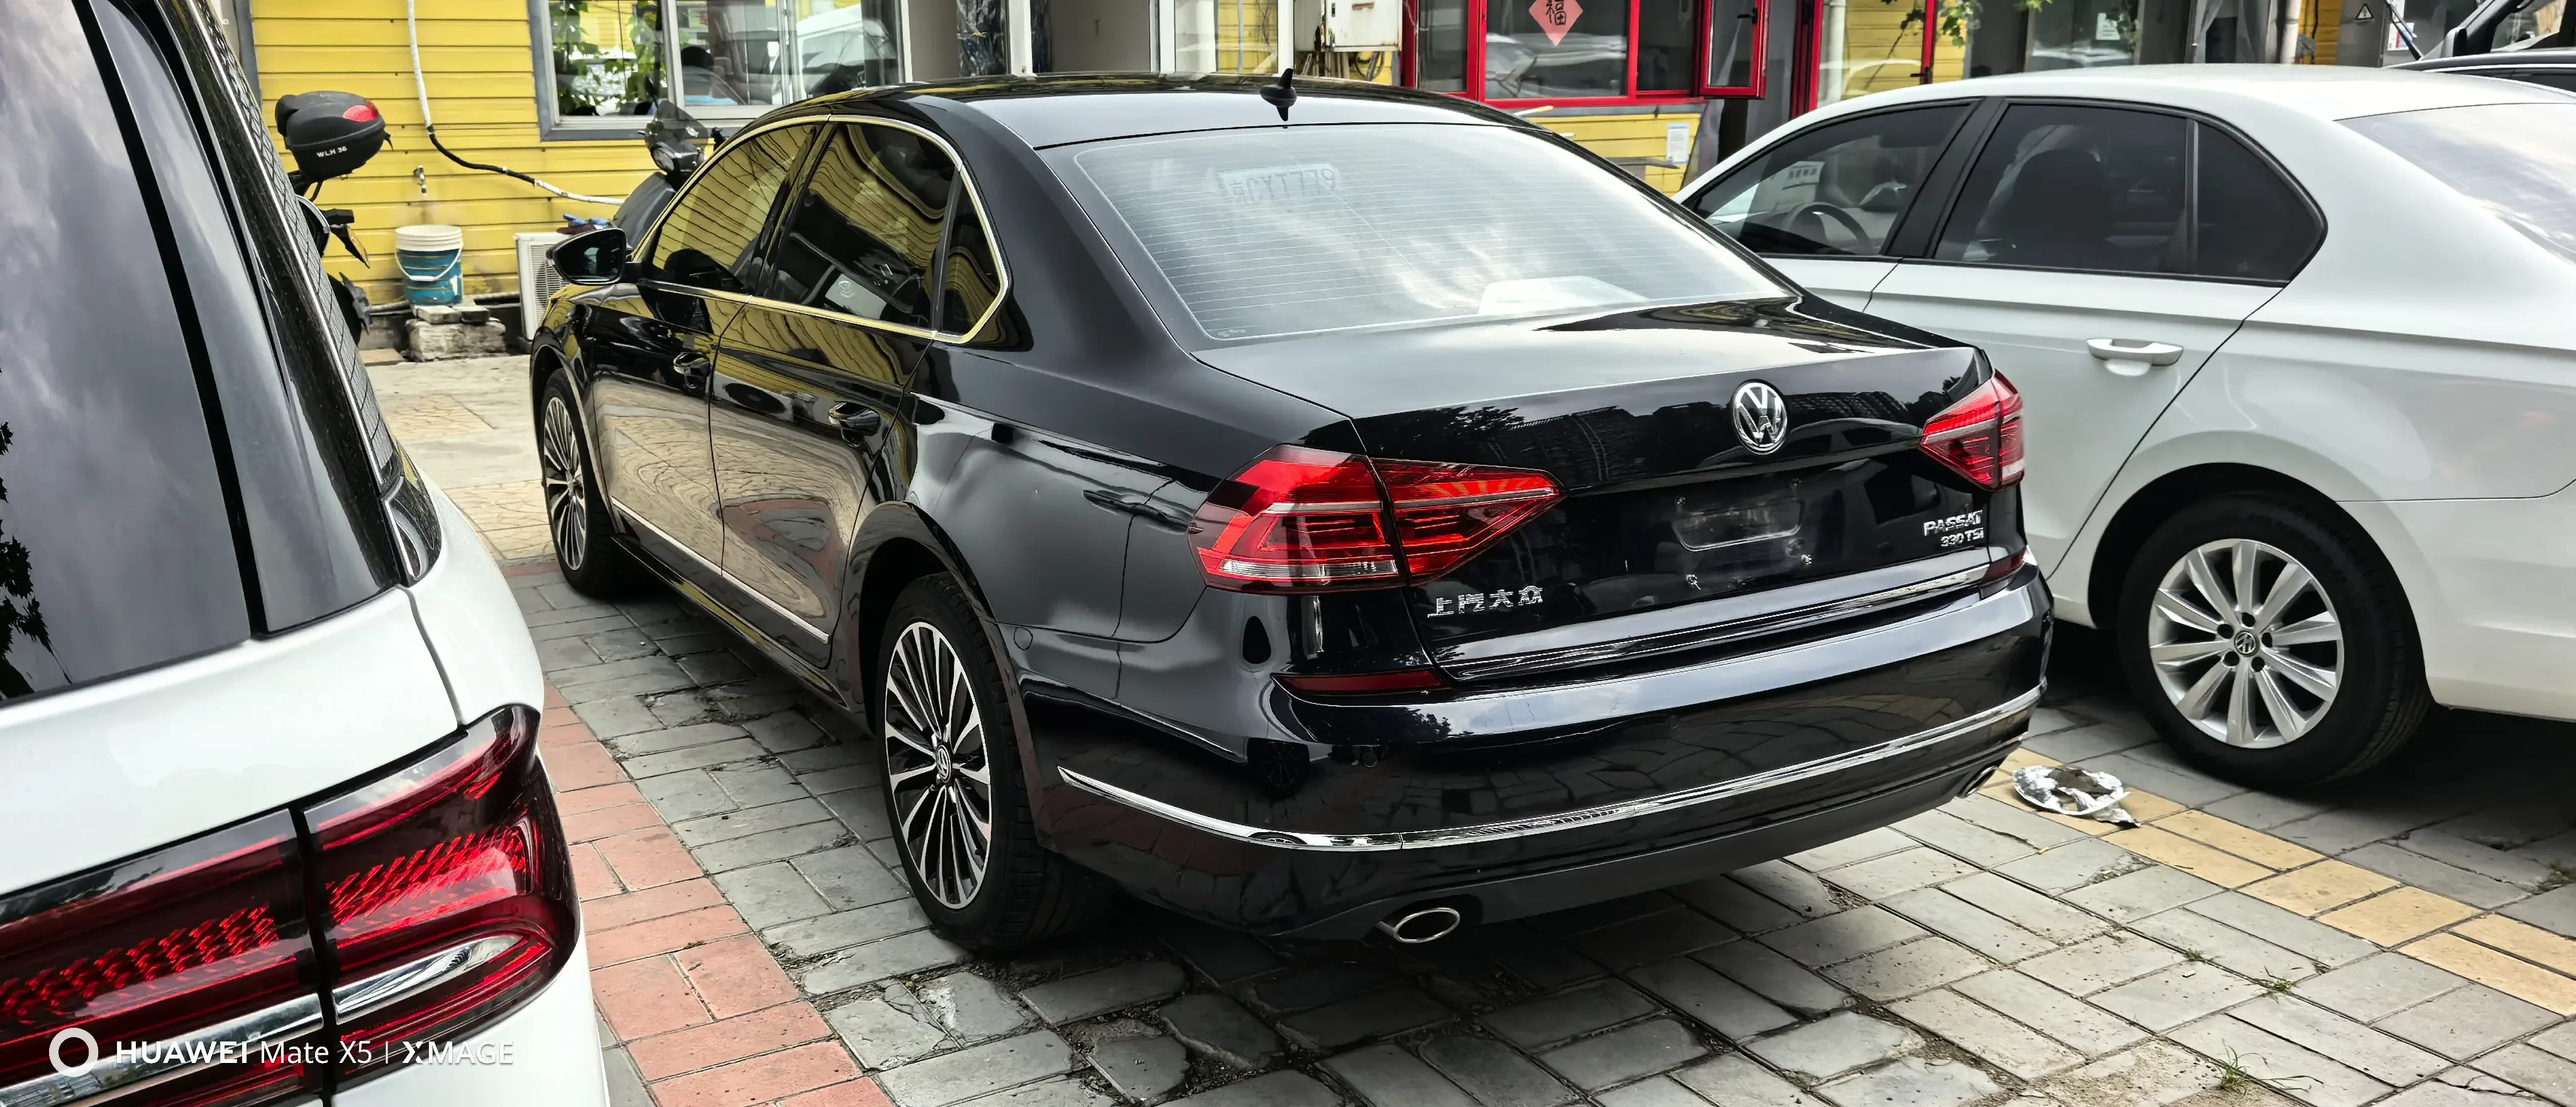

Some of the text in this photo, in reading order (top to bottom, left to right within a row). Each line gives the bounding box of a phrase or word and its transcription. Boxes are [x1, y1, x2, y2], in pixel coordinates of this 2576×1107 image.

[1545, 0, 1567, 26] 福
[1923, 509, 1983, 536] PASSAT
[1940, 527, 1984, 547] 330 TSI
[1427, 585, 1543, 618] 上汽大众
